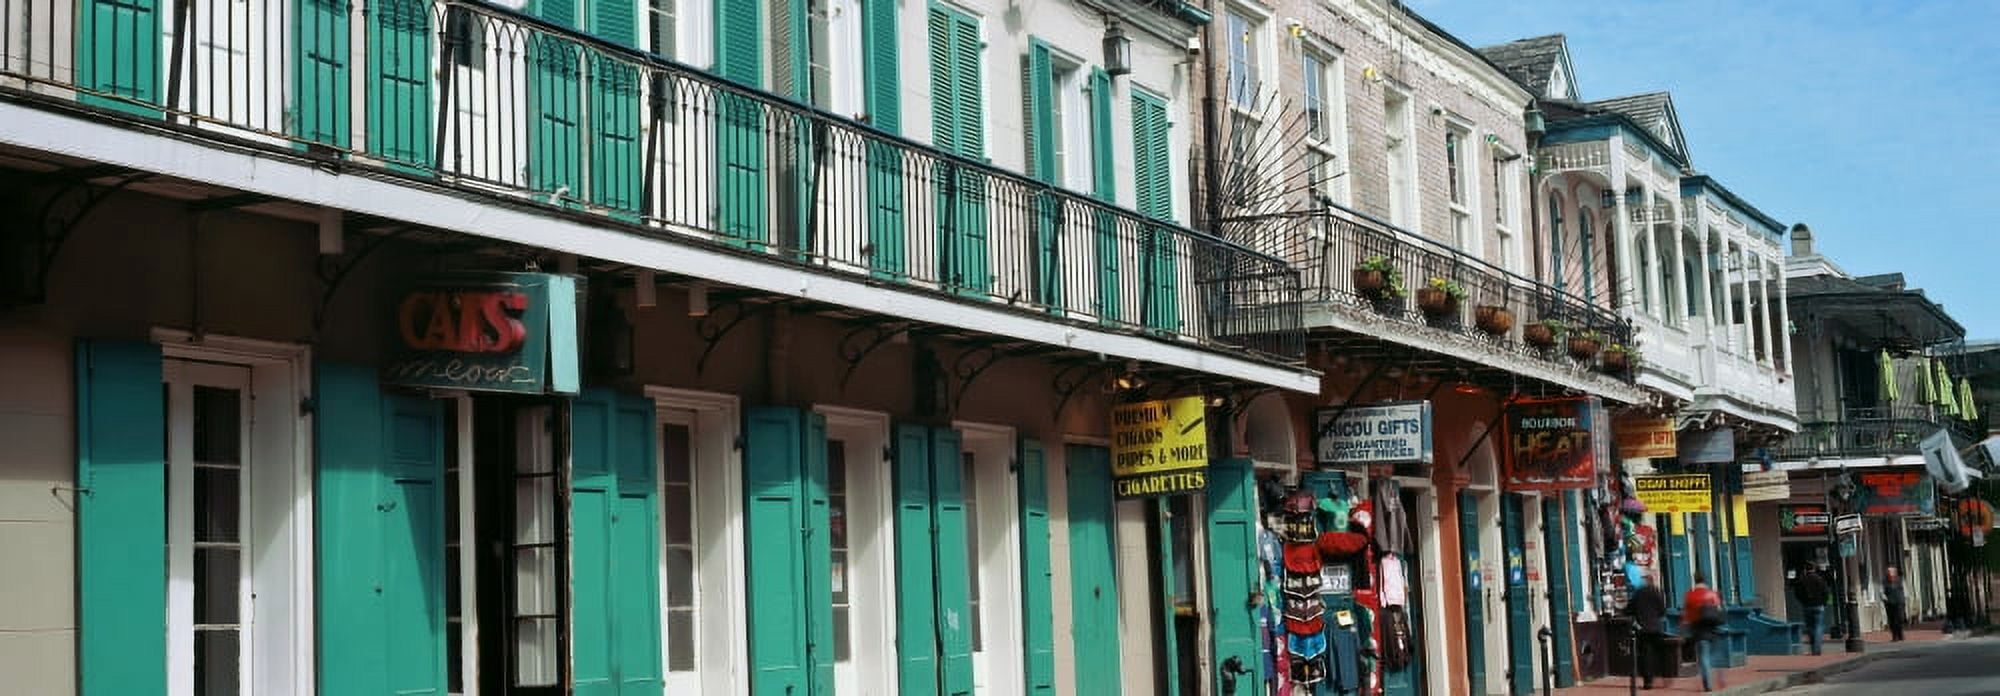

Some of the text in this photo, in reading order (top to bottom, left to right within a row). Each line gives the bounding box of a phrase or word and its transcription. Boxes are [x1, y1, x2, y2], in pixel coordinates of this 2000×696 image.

[398, 292, 529, 353] CATS
[1114, 402, 1172, 426] PREMIUM
[1521, 417, 1576, 430] BOURBON
[1117, 427, 1164, 447] CIGARS
[1378, 418, 1420, 436] GIFTS
[1117, 443, 1204, 468] PIPES & MORE
[1513, 431, 1589, 466] HEAT
[1117, 472, 1206, 497] CIGARETTES
